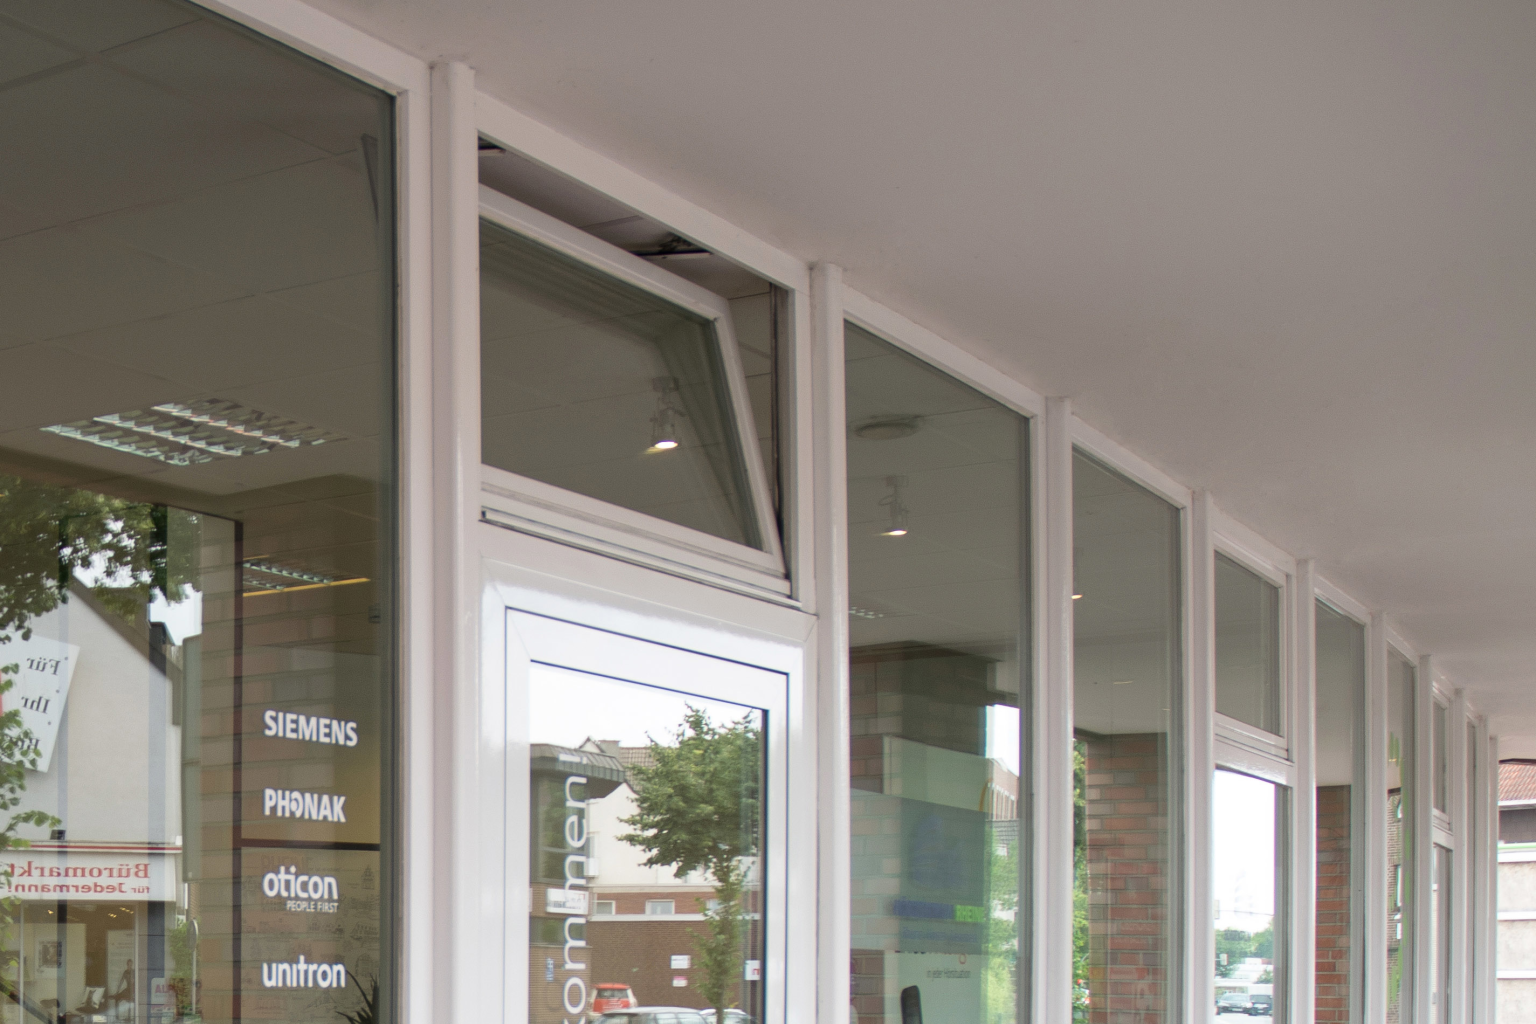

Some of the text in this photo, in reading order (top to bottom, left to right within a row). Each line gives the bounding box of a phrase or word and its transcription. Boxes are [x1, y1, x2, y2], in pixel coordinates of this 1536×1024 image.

[263, 708, 359, 747] SIEMENS
[264, 788, 347, 823] PHONAK
[263, 864, 339, 900] oticon
[286, 900, 339, 914] PEOPLE FIRST
[263, 954, 346, 988] unitron
